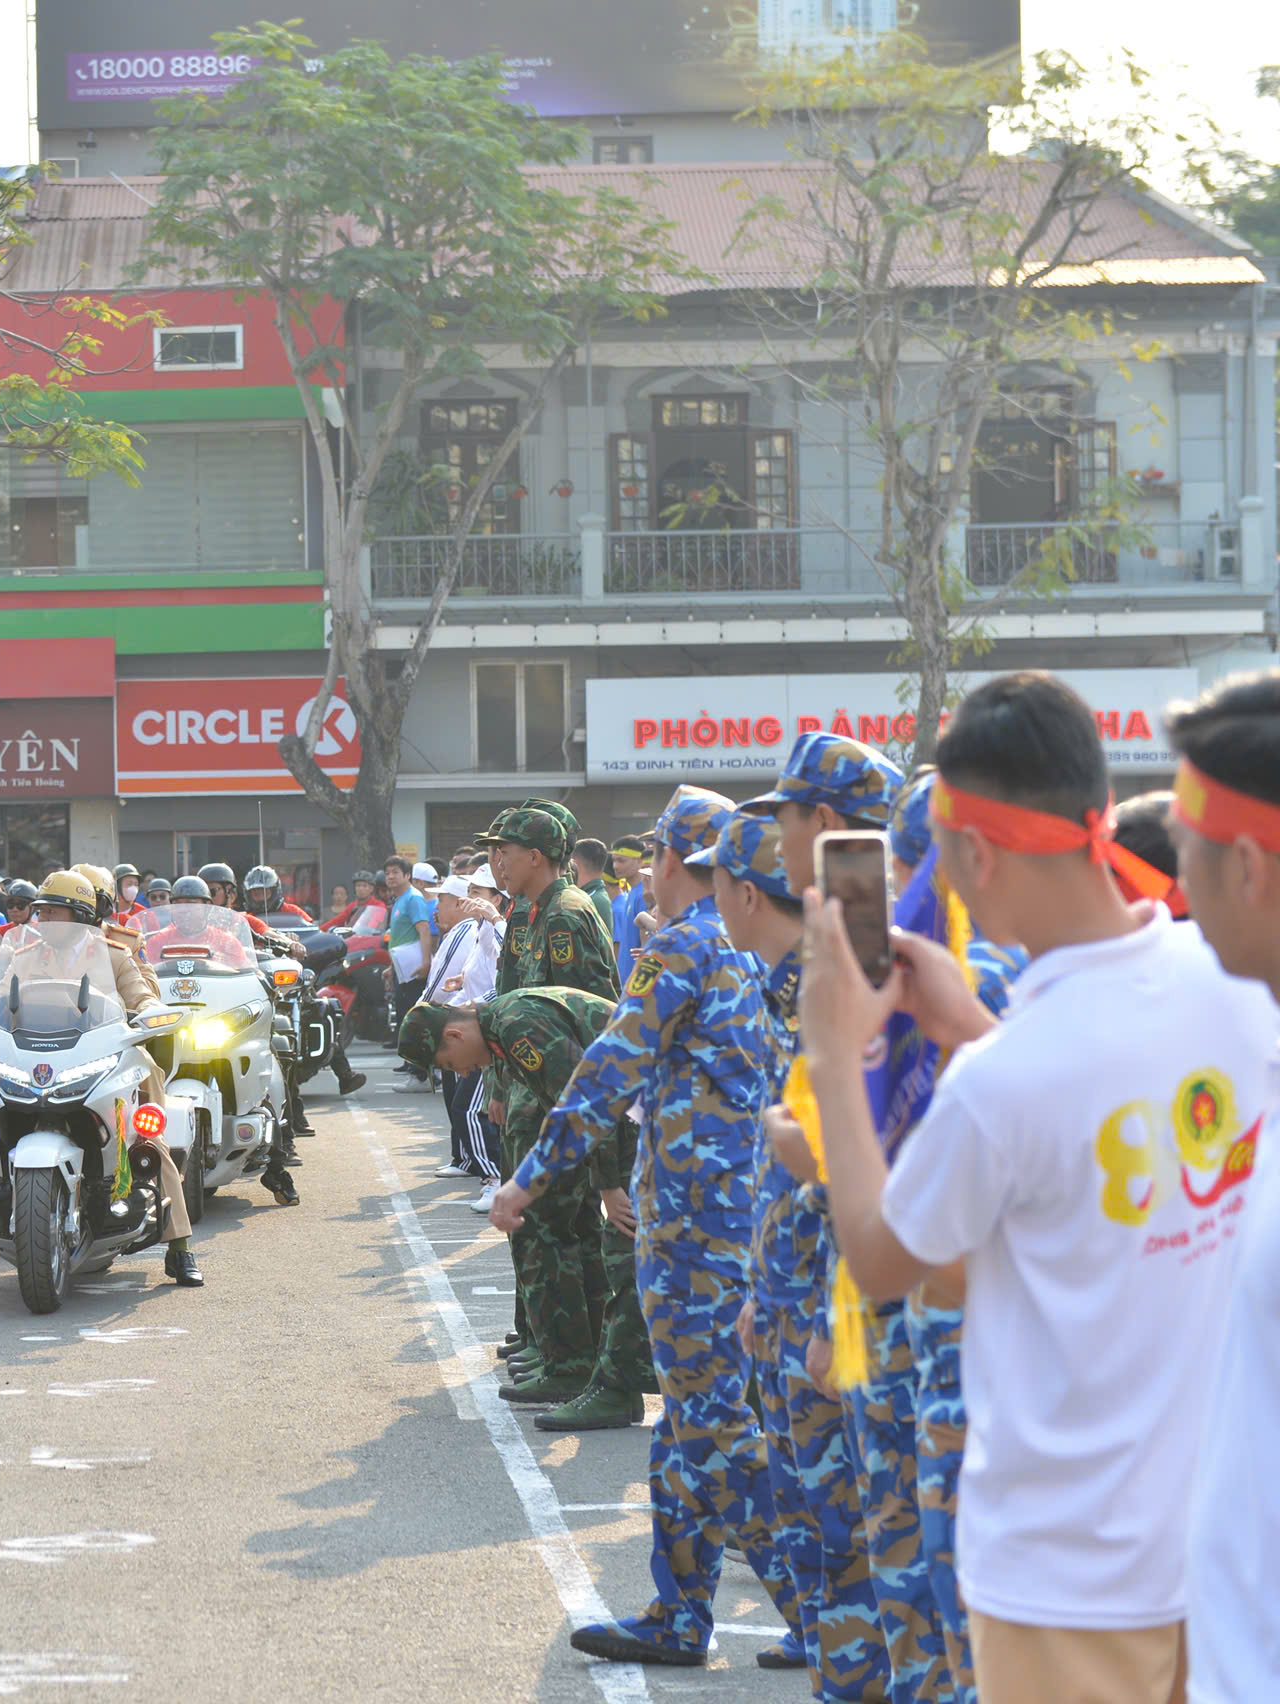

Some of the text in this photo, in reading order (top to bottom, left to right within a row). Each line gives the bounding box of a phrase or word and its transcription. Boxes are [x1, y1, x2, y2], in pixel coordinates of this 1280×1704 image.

[88, 54, 252, 79] 18000 88896
[132, 708, 284, 745] CIRCLE
[634, 709, 783, 748] PHÒNG
[602, 755, 777, 771] 143 ĐINH TIÊN HOÀNG
